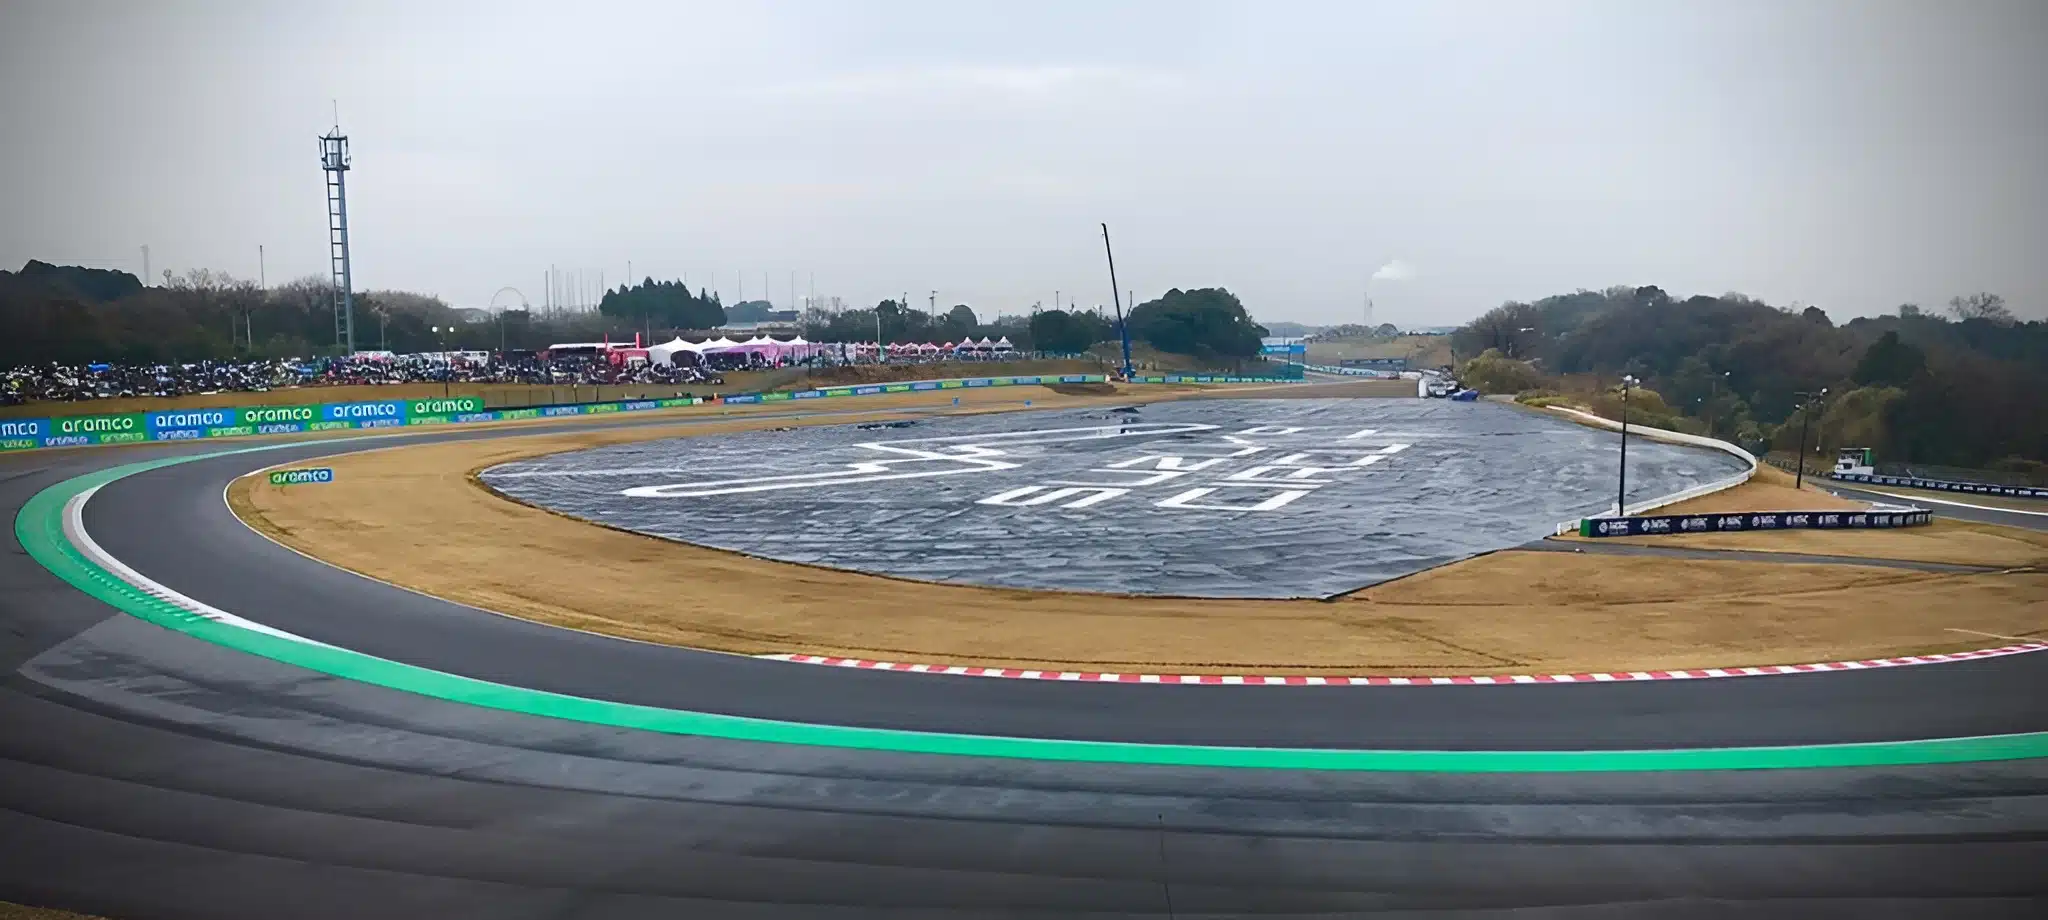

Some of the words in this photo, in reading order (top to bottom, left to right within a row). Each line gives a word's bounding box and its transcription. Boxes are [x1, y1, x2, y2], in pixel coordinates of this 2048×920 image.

[333, 403, 396, 417] aramco
[415, 400, 474, 414] aramco
[155, 412, 223, 427] aramco
[245, 408, 312, 422] aramco
[62, 418, 133, 432] aramco
[272, 470, 329, 483] aramco
